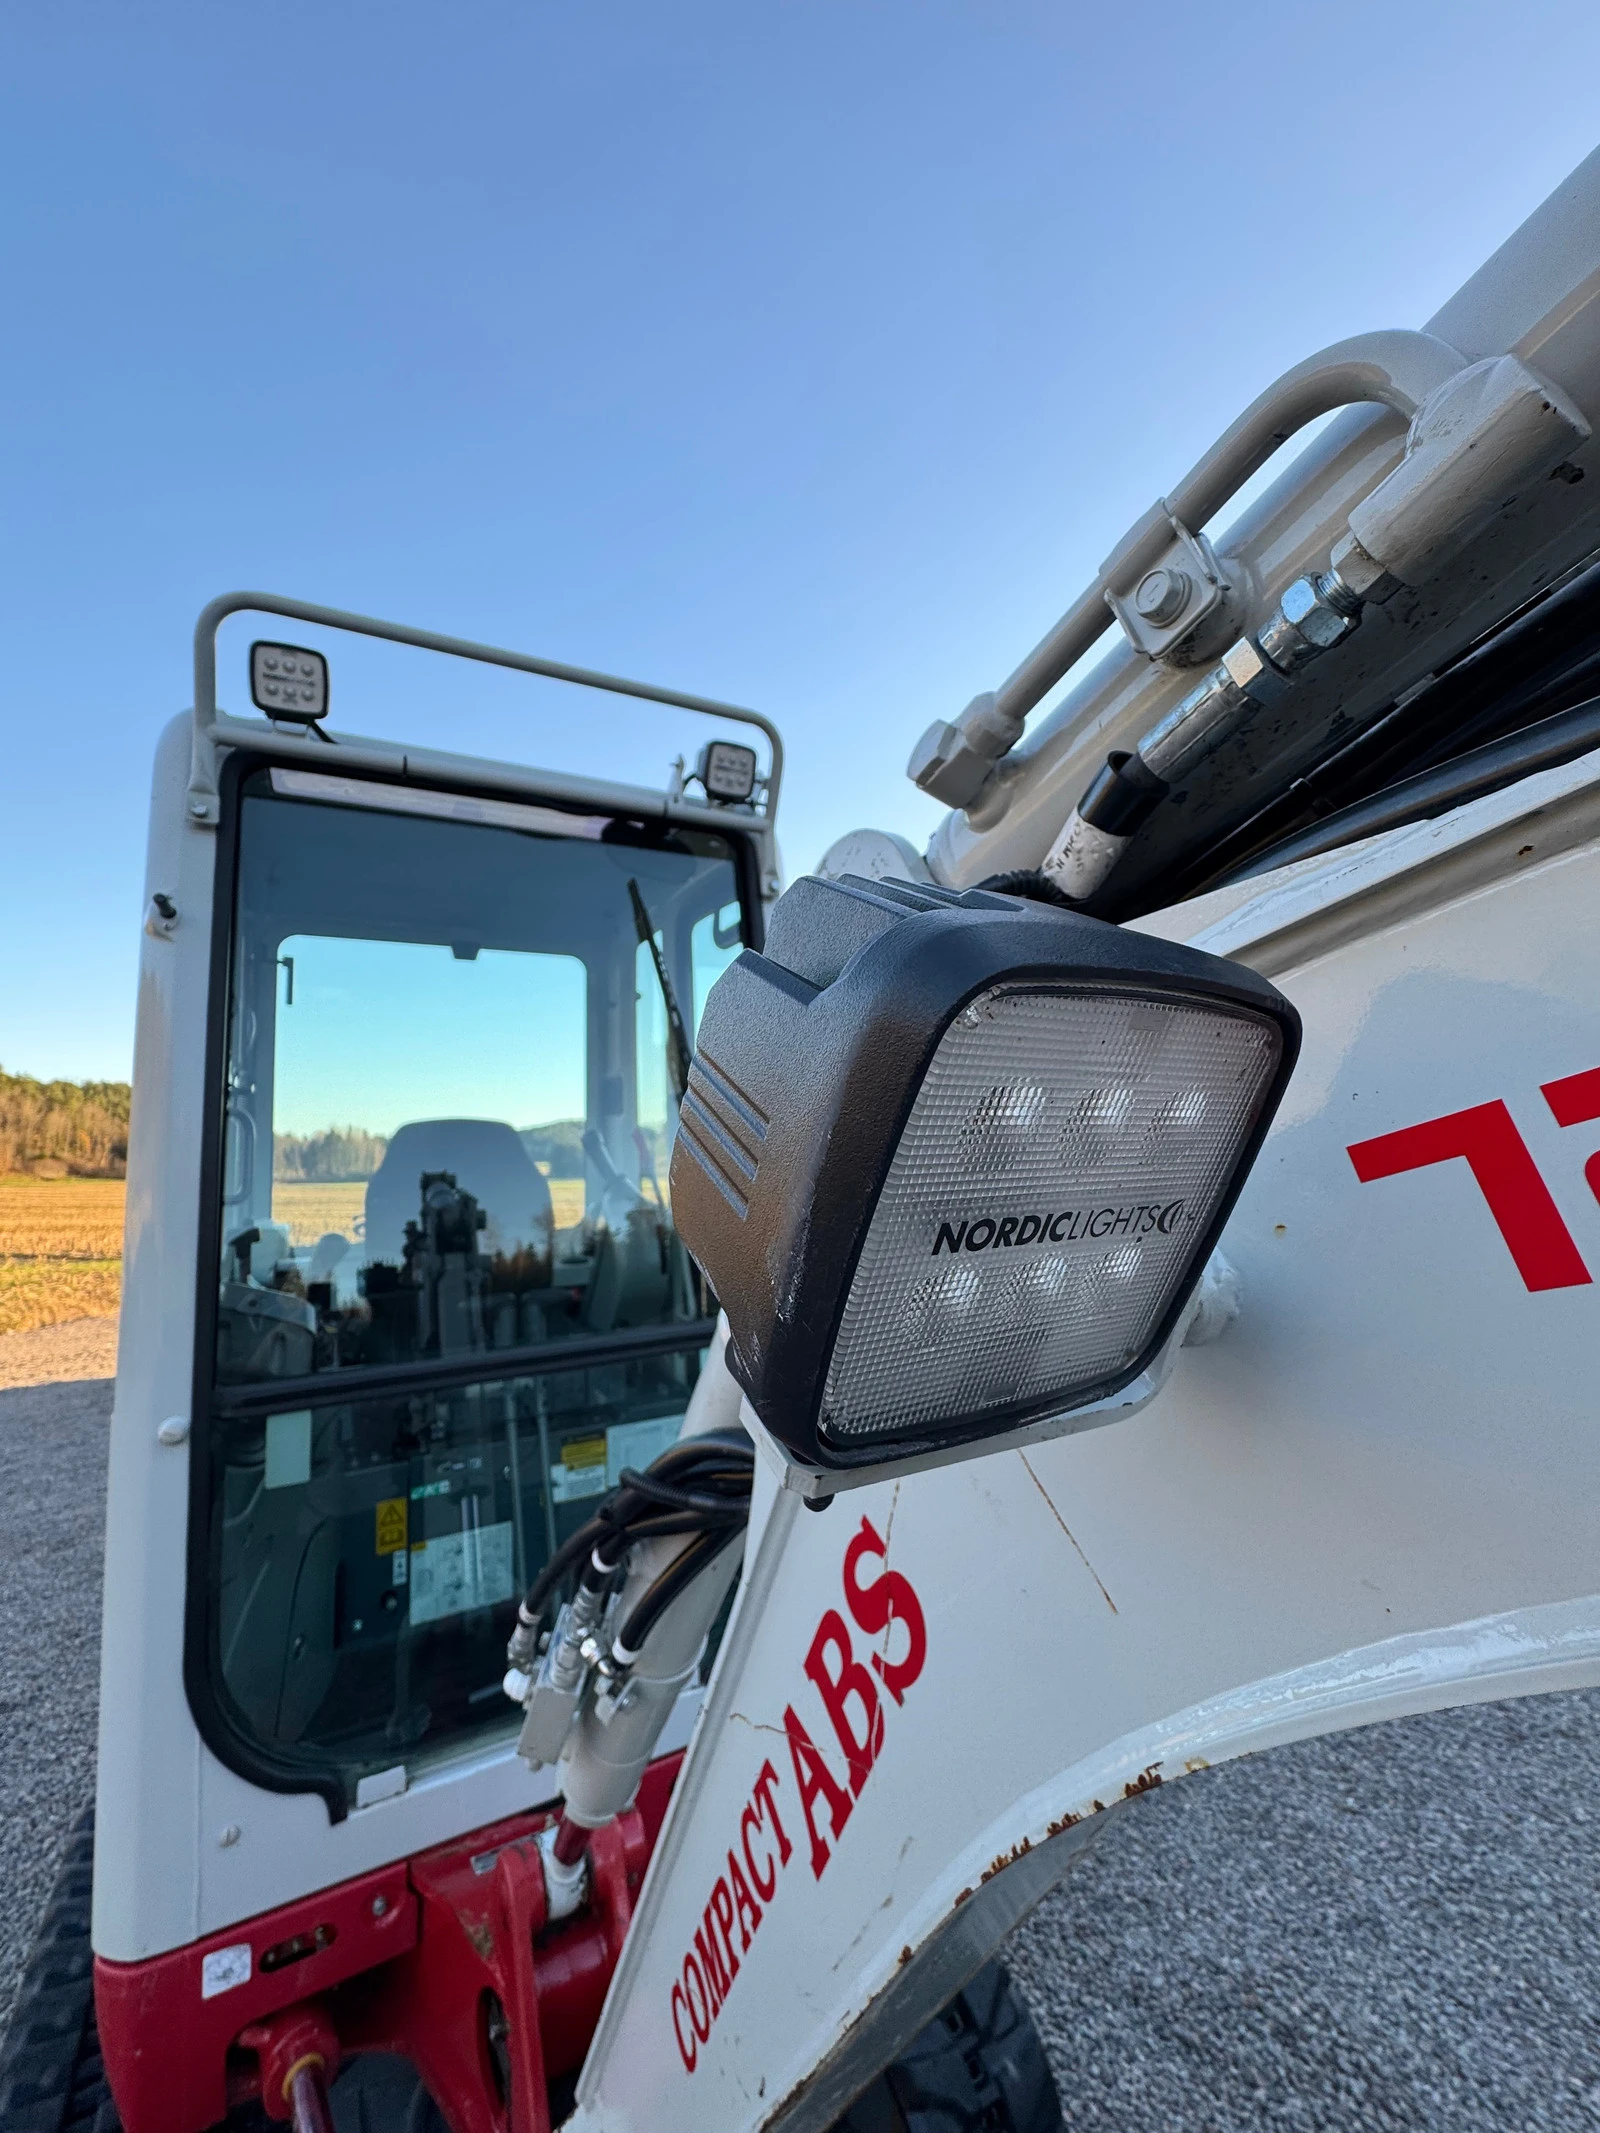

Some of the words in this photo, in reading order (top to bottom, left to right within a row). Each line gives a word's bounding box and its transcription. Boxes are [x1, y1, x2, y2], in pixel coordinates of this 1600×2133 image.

[931, 1204, 1161, 1256] NORDICLIGHTS
[670, 1758, 793, 2074] COMPACT
[781, 1514, 926, 1881] ABS
